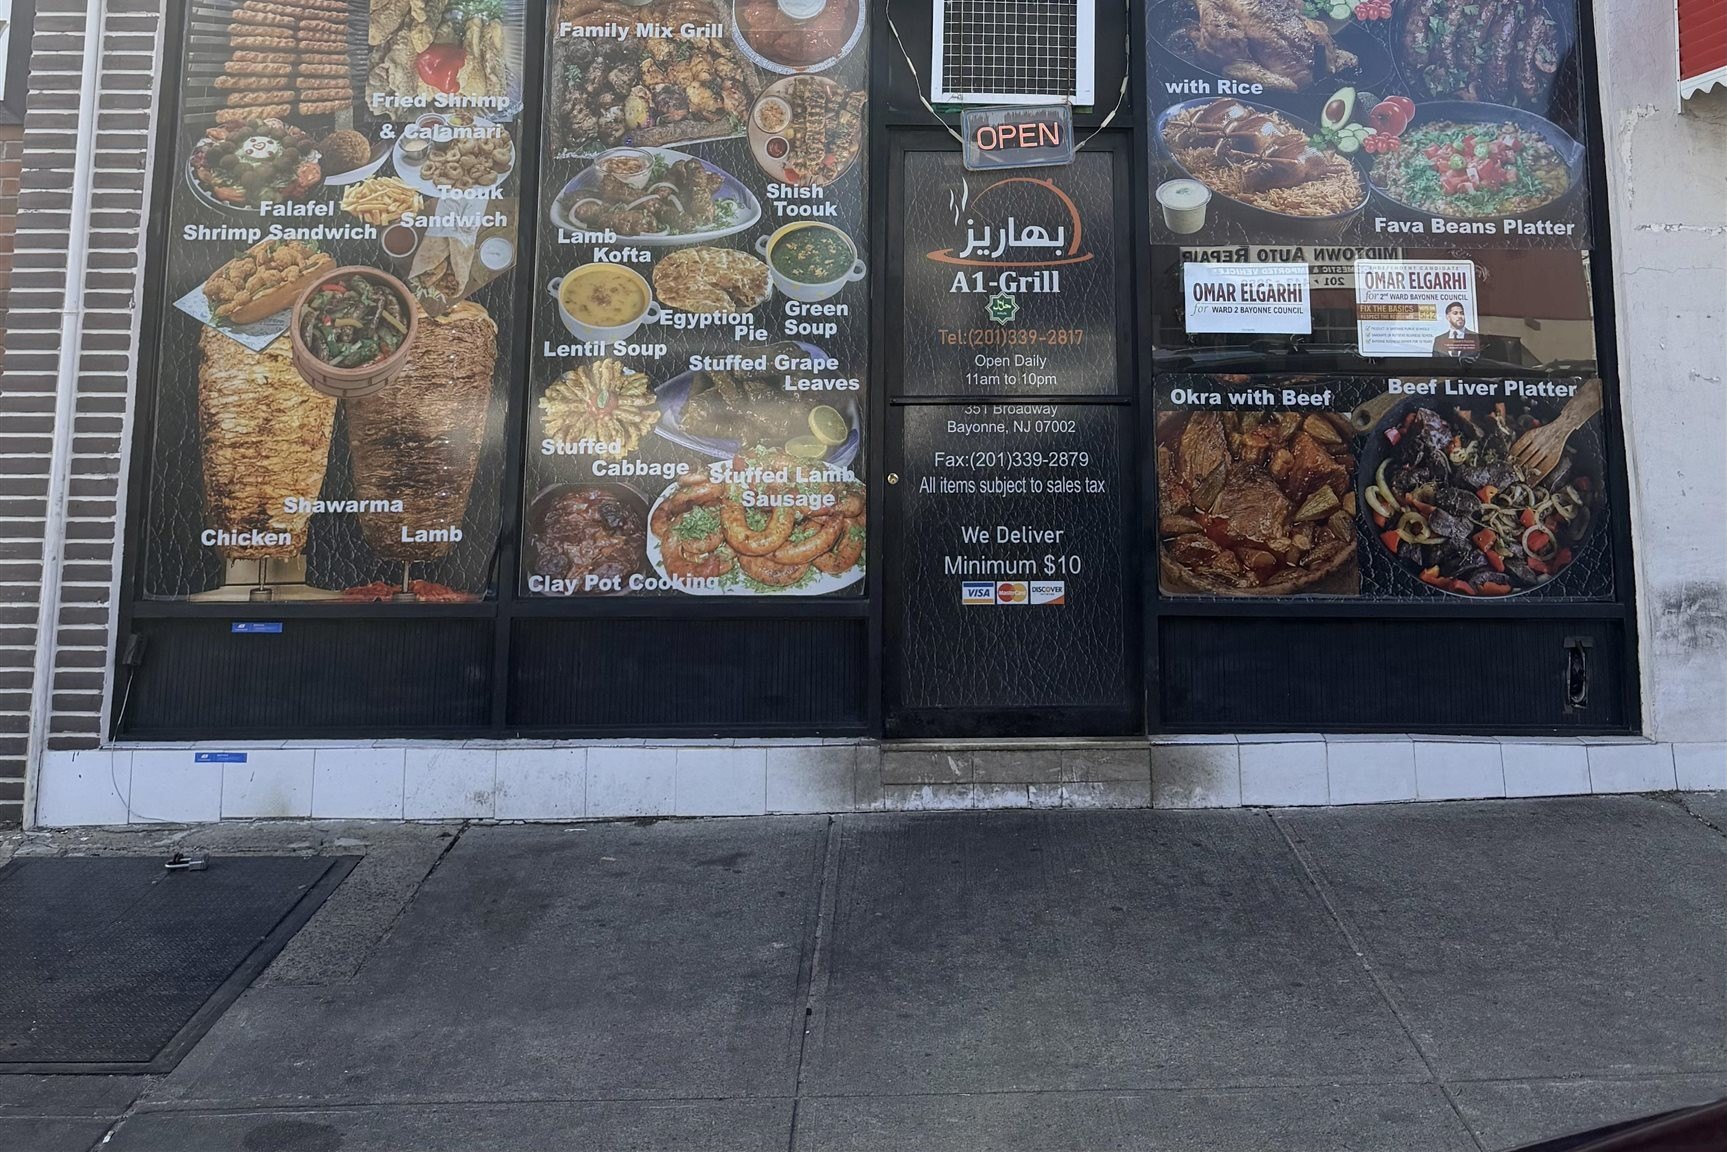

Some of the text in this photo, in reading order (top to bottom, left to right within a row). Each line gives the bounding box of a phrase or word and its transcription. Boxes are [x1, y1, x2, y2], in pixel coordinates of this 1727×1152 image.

[559, 22, 723, 40] Family Mix Grill
[1165, 79, 1263, 95] with Rice
[372, 92, 510, 111] Fried Shrimp
[380, 124, 501, 139] & Calamari
[976, 121, 1060, 151] OPEN
[437, 185, 504, 200] Toouk
[766, 183, 824, 198] Shish
[260, 201, 334, 217] Falafel
[773, 201, 837, 216] Toouk
[400, 212, 507, 228] Sandwich
[1375, 218, 1575, 235] Fava Beans Platter
[183, 224, 377, 243] Shrimp Sandwich
[558, 229, 617, 244] Lamb
[959, 217, 1064, 258] بهاريز
[593, 247, 651, 263] Kofta
[950, 271, 1060, 293] A1-Grill
[1365, 272, 1466, 289] OMAR ELGARHI
[1193, 283, 1302, 302] OMAR ELGARHI
[1363, 291, 1378, 302] for
[785, 301, 848, 317] Green
[1191, 304, 1208, 316] for
[1389, 305, 1414, 313] BASICS
[659, 310, 754, 328] Egyption
[735, 325, 768, 341] Pie
[784, 319, 837, 338] Soup
[938, 329, 1084, 347] Tel:(201)339-2817
[543, 341, 667, 359] Lentil Soup
[689, 355, 839, 374] Stuffed Grape
[975, 354, 1047, 369] Open Daily
[785, 375, 860, 391] Leaves
[965, 373, 1057, 387] 11am to 10pm
[1388, 379, 1577, 397] Beef Liver Platter
[1170, 389, 1331, 406] Okra with Beef
[965, 405, 1058, 417] 351 Broadway
[947, 421, 1076, 435] Bayonne, NJ 07002
[541, 439, 621, 455] Stuffed
[592, 460, 689, 479] Cabbage
[935, 452, 1089, 470] Fax:(201)339-2879
[709, 467, 856, 483] Stuffed Lamb
[919, 477, 1105, 497] All items subject to sales tax
[284, 497, 404, 514] Shawarma
[742, 491, 835, 510] Sausage
[201, 528, 291, 546] Chicken
[401, 526, 462, 543] Lamb
[961, 526, 1064, 544] We Deliver
[945, 555, 1081, 575] Minimum $10
[528, 573, 720, 595] Clay Pot Cooking
[968, 589, 990, 598] VISA
